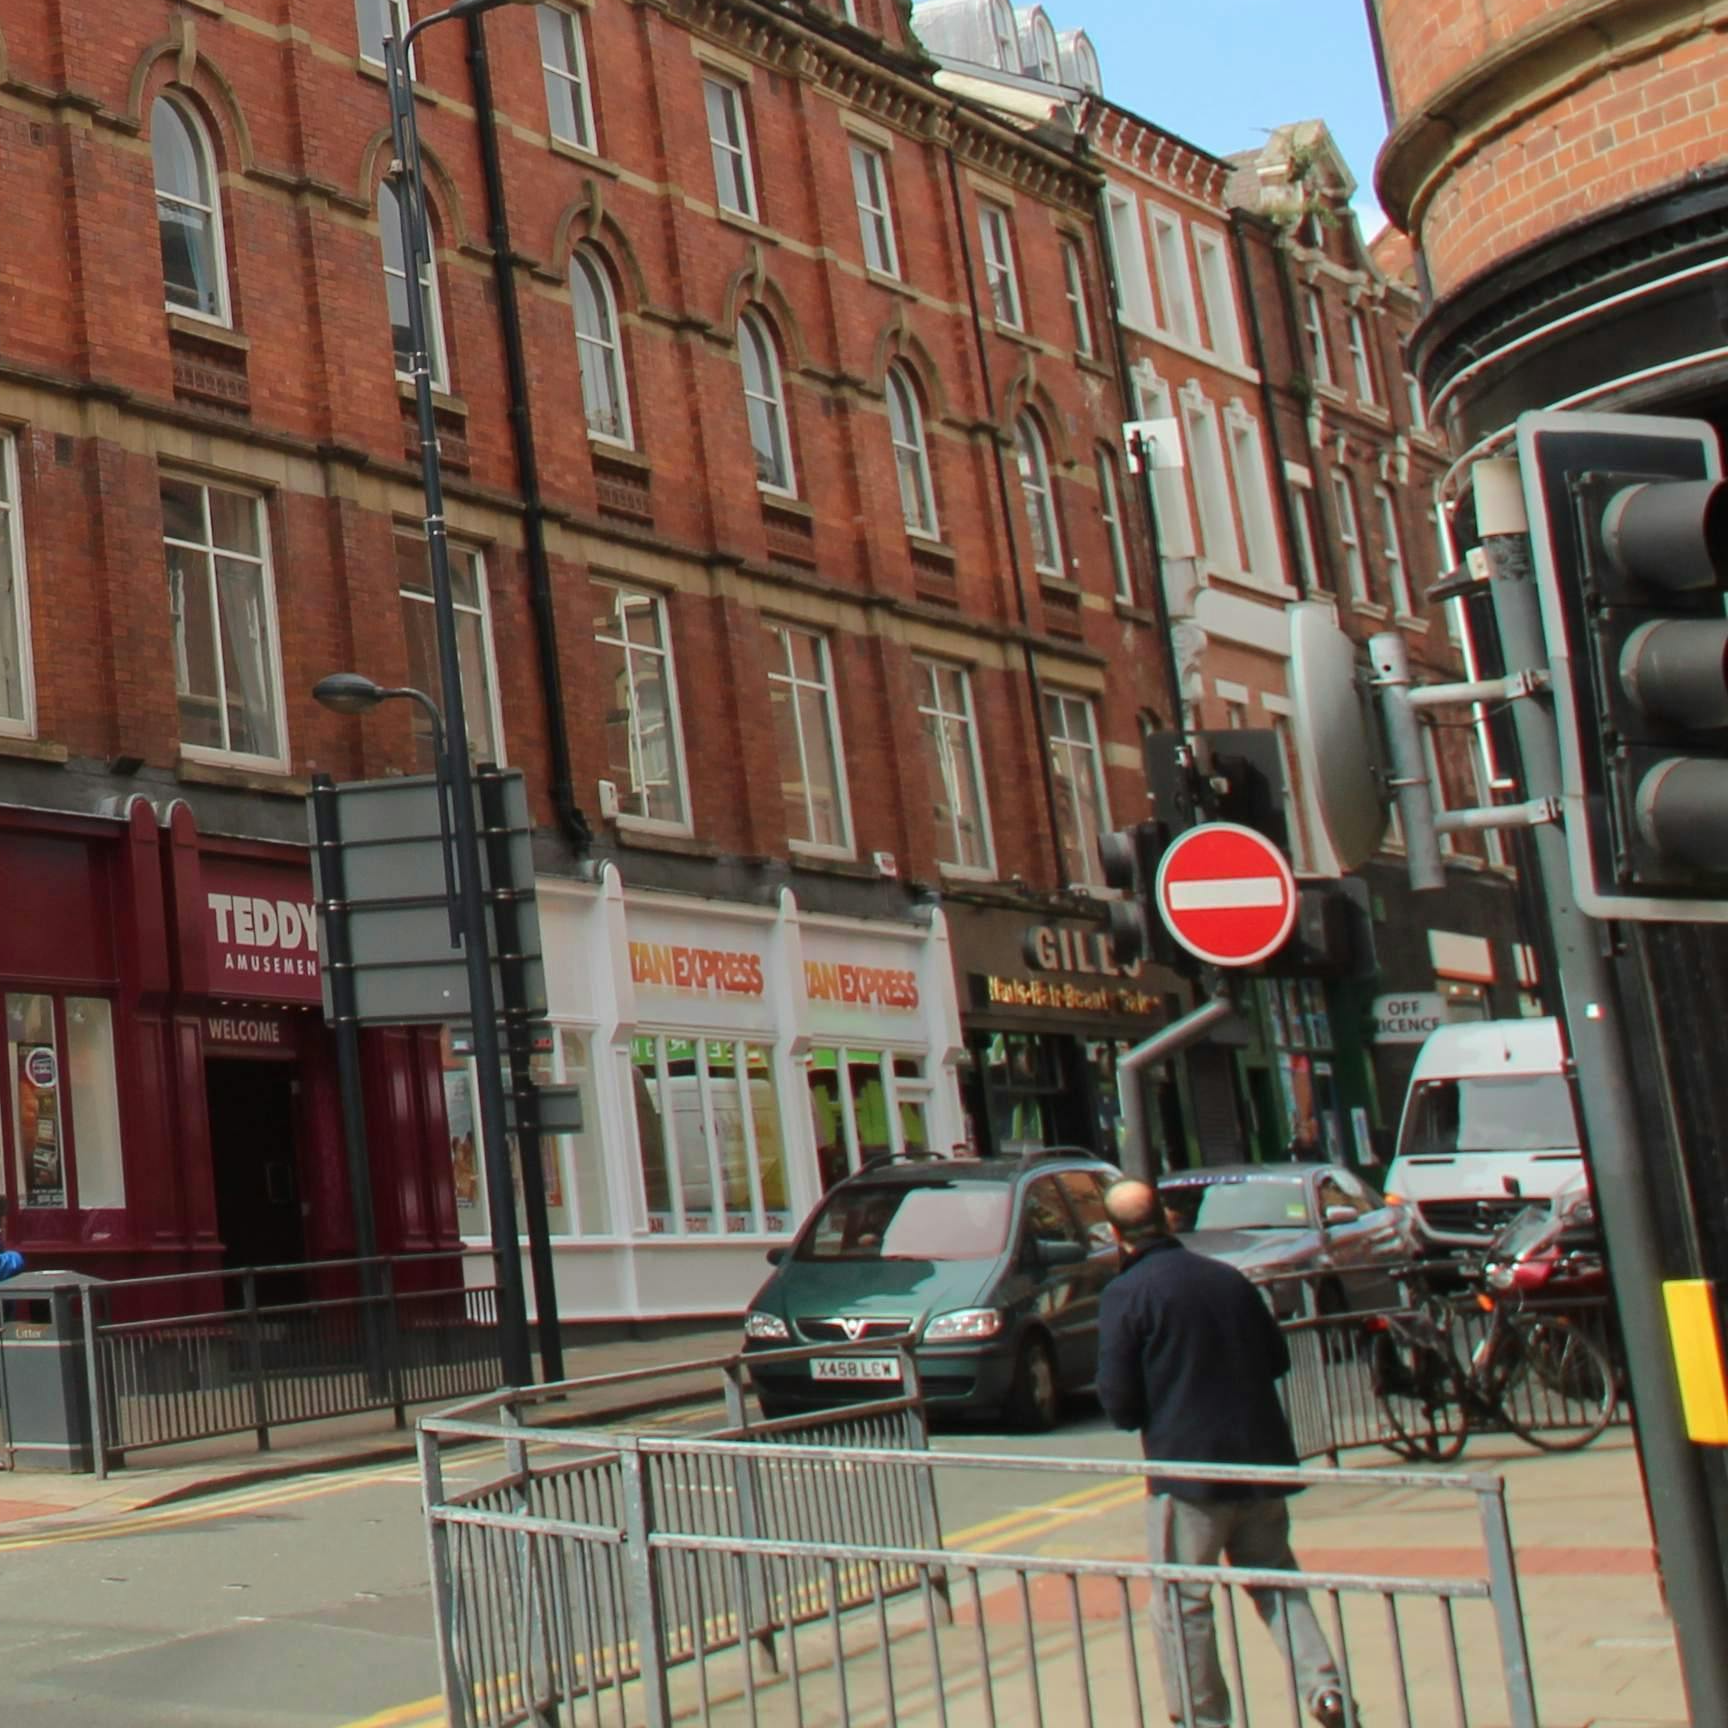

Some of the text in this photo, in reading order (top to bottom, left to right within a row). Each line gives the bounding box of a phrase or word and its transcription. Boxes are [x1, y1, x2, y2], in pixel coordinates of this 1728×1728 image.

[208, 893, 318, 952] TEDDY
[225, 953, 316, 977] AMUSEMEN
[1387, 1000, 1420, 1016] OFF
[208, 1018, 280, 1043] WELCOME
[1378, 1016, 1441, 1033] ICENCE
